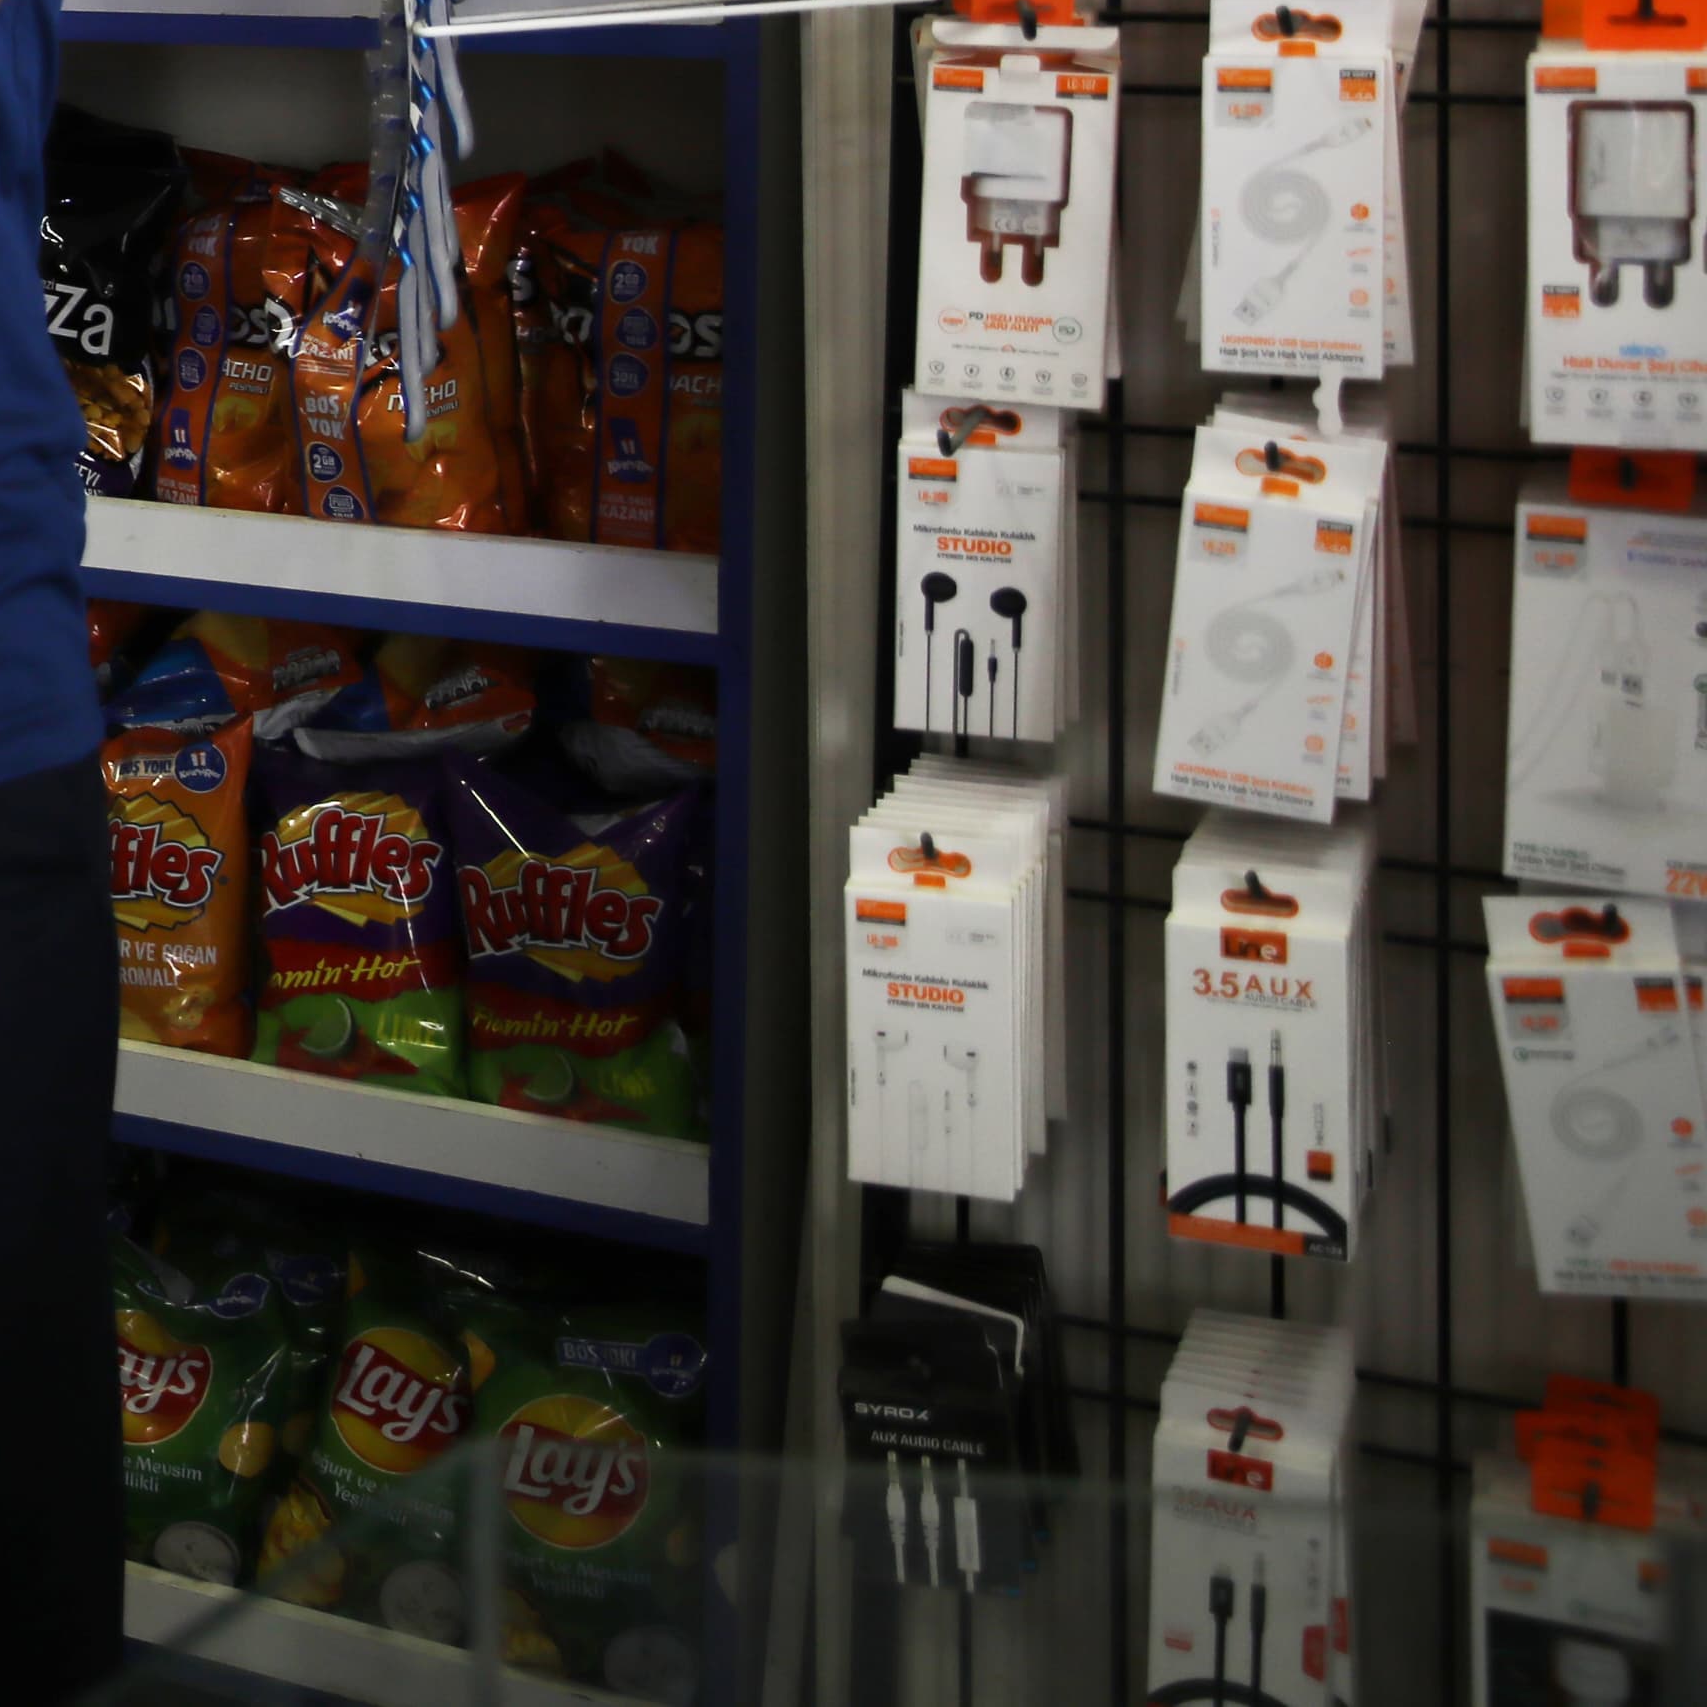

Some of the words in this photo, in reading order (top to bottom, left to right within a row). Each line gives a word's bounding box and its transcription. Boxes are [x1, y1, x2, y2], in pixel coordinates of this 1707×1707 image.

[306, 418, 345, 440] YOK
[937, 536, 1013, 556] STUDIO
[459, 856, 665, 961] Ruffles
[135, 941, 156, 962] VE
[886, 982, 965, 1004] STUDIO
[1192, 967, 1239, 1000] 3.5
[332, 1346, 468, 1443] Lay's
[853, 1401, 930, 1421] SYROX
[870, 1429, 898, 1445] AUX
[900, 1433, 940, 1450] AUDIO
[942, 1438, 986, 1456] CABLE
[502, 1423, 639, 1516] Lay's
